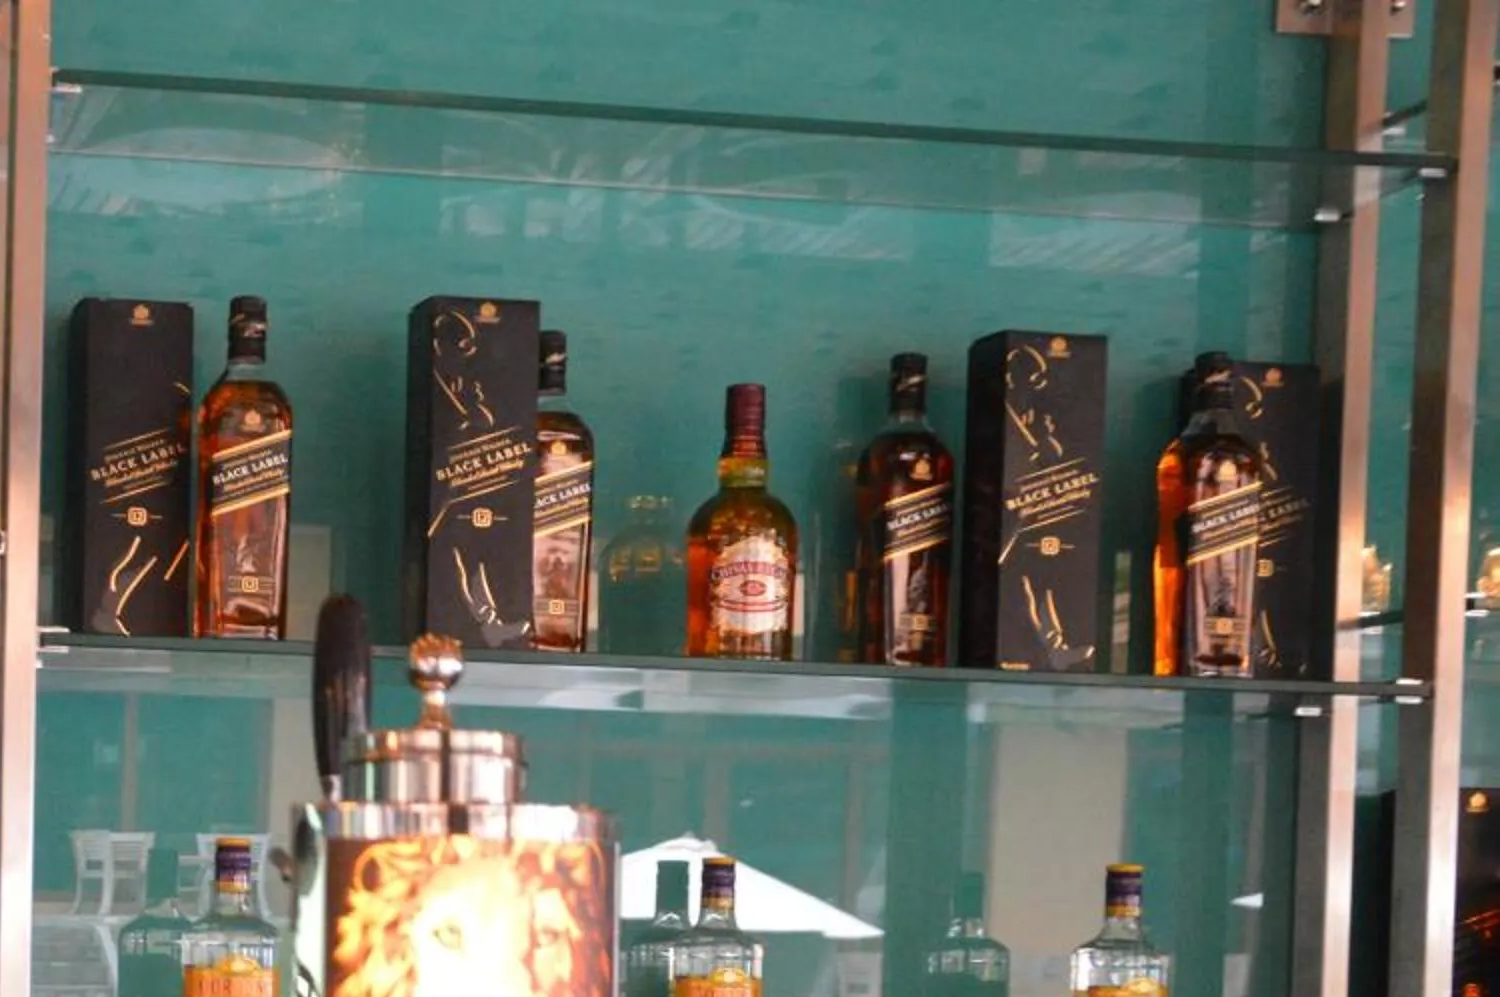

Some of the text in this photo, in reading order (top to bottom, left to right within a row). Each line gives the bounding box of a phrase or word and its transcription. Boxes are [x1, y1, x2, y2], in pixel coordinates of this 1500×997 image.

[90, 457, 138, 480] BLACK
[141, 443, 187, 464] LABEL
[212, 466, 250, 484] BLACK
[251, 453, 288, 472] LABEL
[436, 457, 483, 480] BLACK
[486, 442, 532, 464] LABEL
[535, 492, 558, 507] ACK
[1005, 487, 1051, 510] BLACK
[1054, 473, 1099, 495] LABEL
